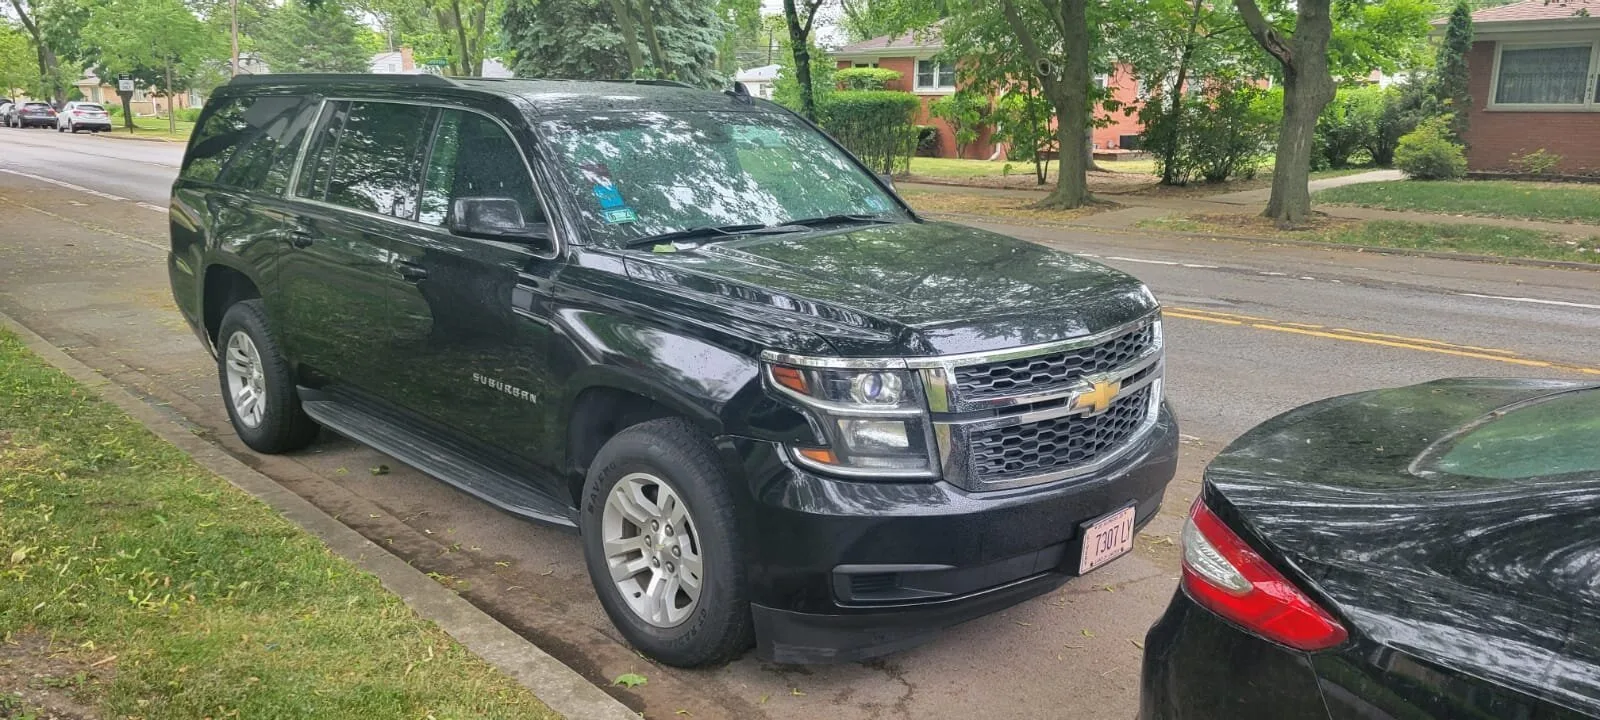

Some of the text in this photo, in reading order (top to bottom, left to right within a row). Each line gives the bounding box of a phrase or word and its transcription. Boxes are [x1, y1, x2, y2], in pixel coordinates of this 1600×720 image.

[472, 372, 537, 404] SUBURBAN
[1095, 524, 1119, 556] 7307
[1121, 517, 1133, 543] LY
